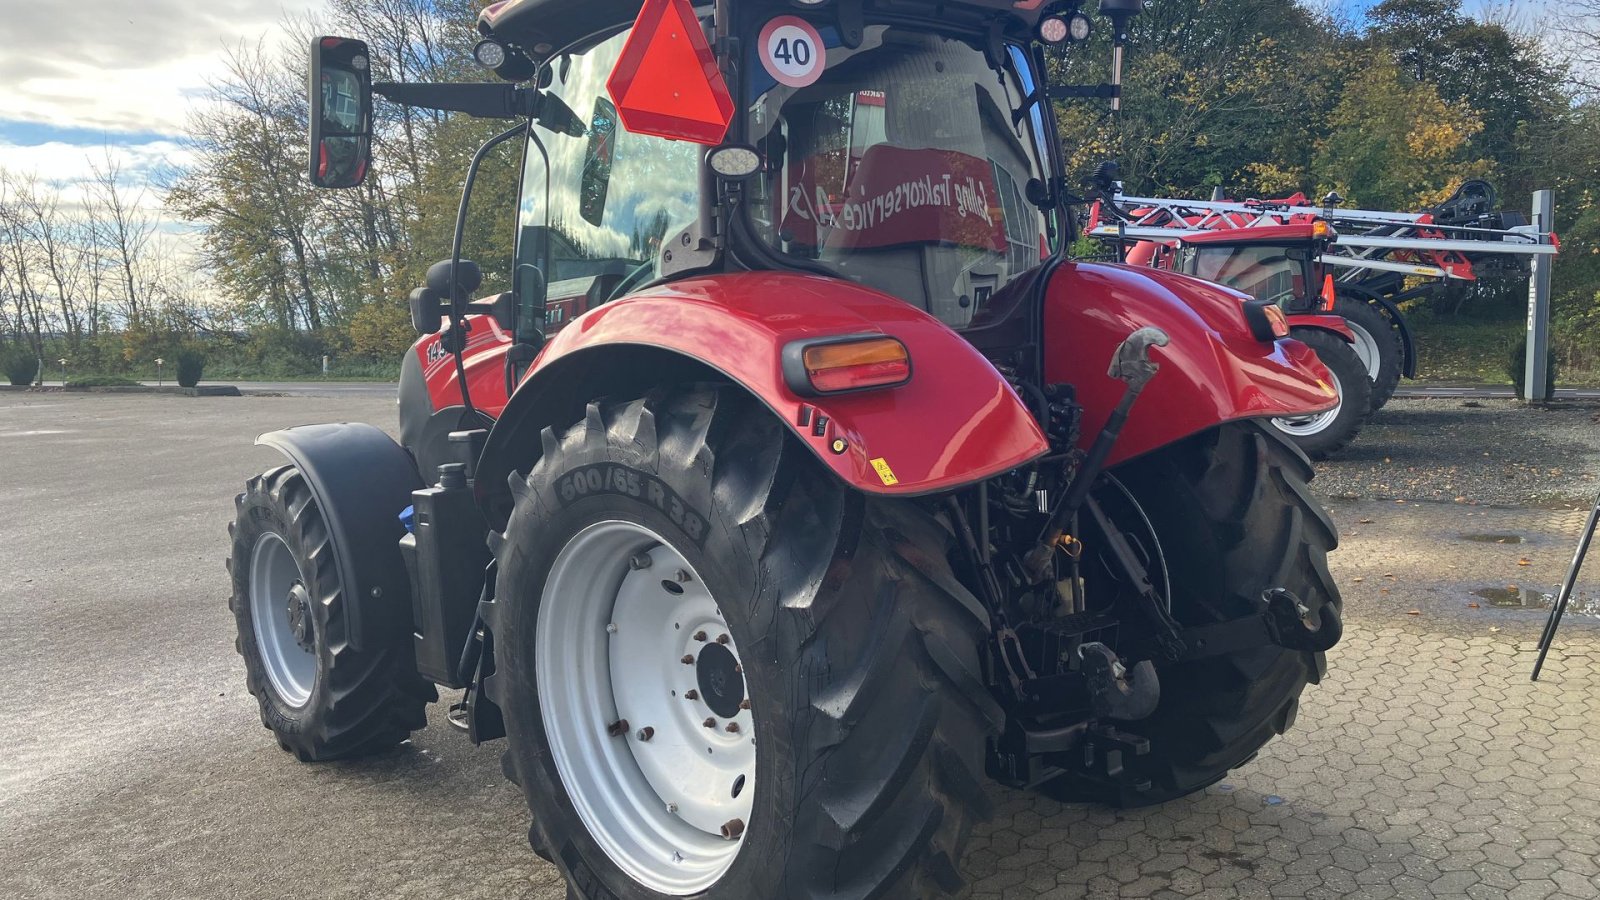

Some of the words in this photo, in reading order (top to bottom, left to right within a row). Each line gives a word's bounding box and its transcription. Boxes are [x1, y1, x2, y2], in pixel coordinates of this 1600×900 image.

[774, 38, 810, 66] 40
[561, 466, 641, 501] 600/65
[648, 478, 665, 510] R
[669, 496, 704, 541] 38
